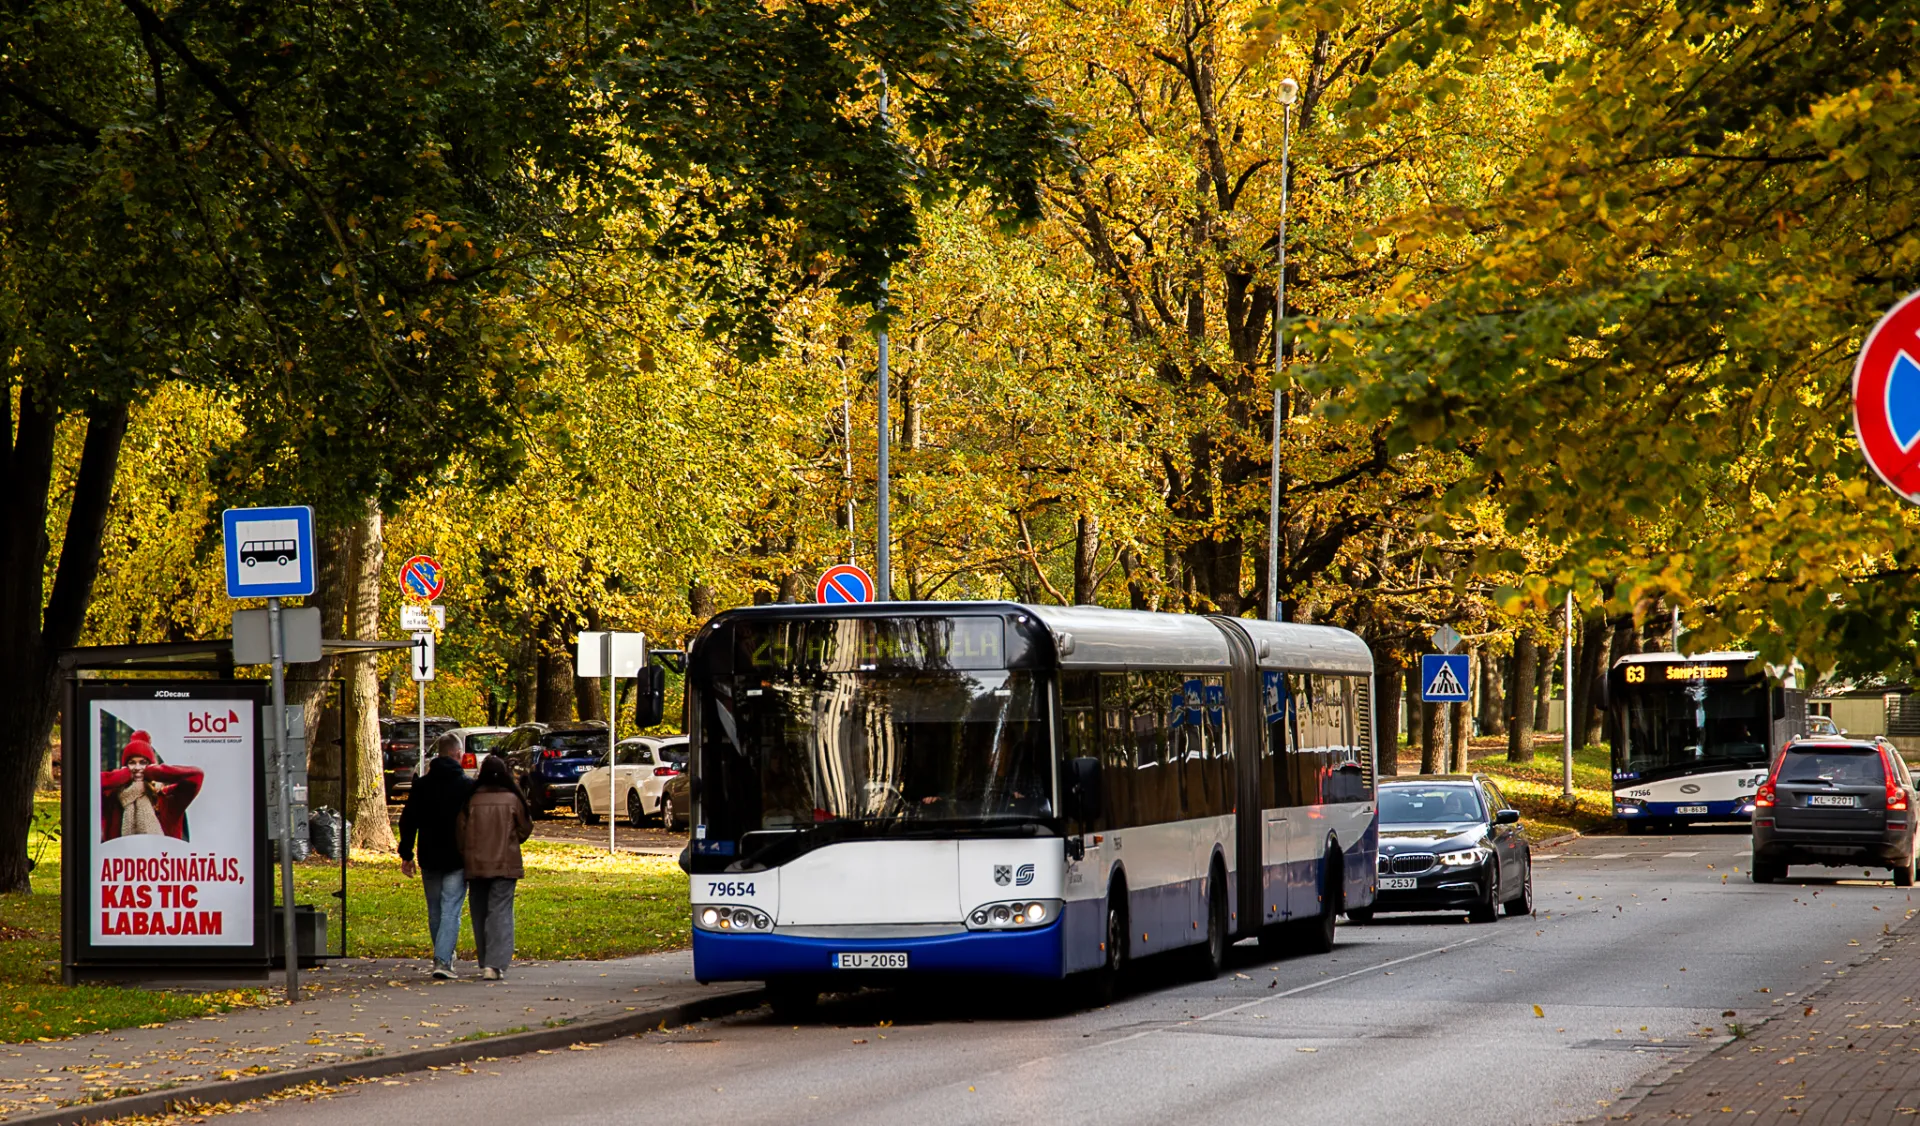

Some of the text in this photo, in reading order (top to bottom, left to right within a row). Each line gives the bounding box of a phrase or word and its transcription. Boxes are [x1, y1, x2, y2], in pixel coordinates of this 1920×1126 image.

[1626, 665, 1646, 683] 63
[154, 690, 190, 698] JCDecaux
[189, 711, 227, 733] bta
[1630, 789, 1651, 797] 77566
[1814, 796, 1853, 805] KL-9201
[101, 852, 245, 885] APDROŠINĀTĀJS,
[101, 885, 199, 909] KAS TIC
[708, 882, 756, 897] 79654
[101, 911, 222, 935] LABAJAM
[842, 954, 906, 967] EU-2069
